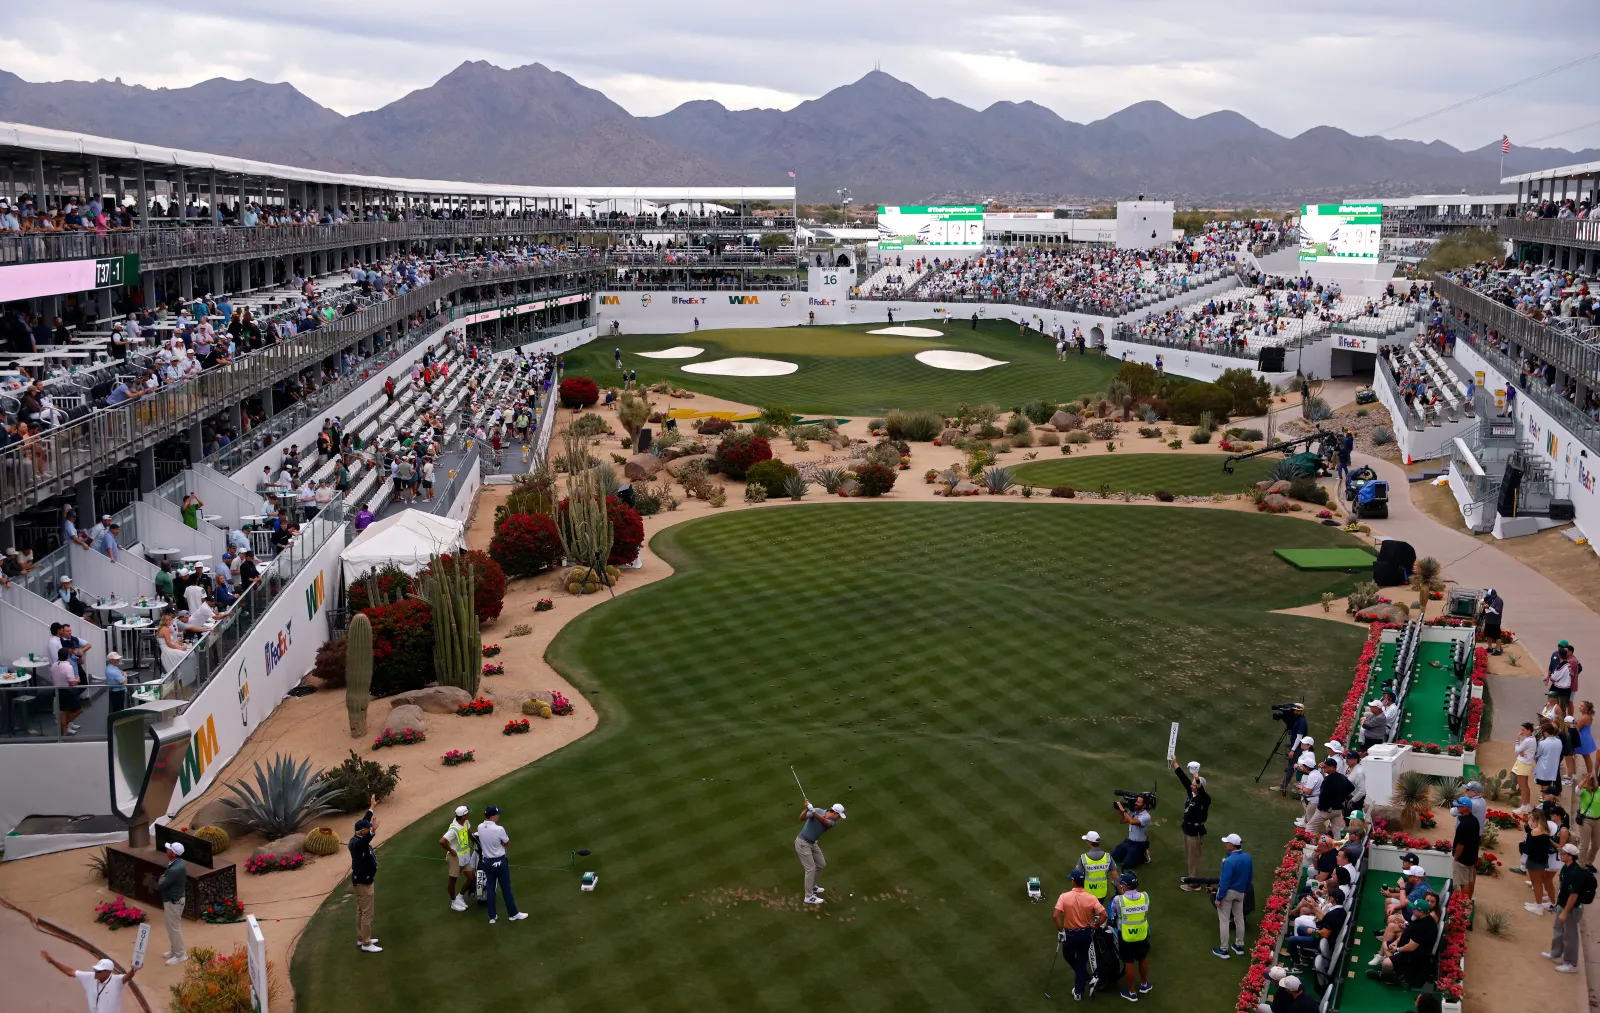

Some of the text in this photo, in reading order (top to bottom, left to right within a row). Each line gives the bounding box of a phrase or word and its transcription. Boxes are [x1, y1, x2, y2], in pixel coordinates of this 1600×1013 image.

[97, 262, 119, 283] T37 -1
[824, 274, 837, 285] 16
[599, 296, 620, 305] WM
[728, 296, 759, 304] WM
[1344, 338, 1360, 349] FedEx
[306, 569, 325, 621] WM
[270, 630, 288, 670] FedEx
[238, 680, 249, 705] WM
[179, 713, 219, 799] WM
[138, 929, 146, 951] QUIET
